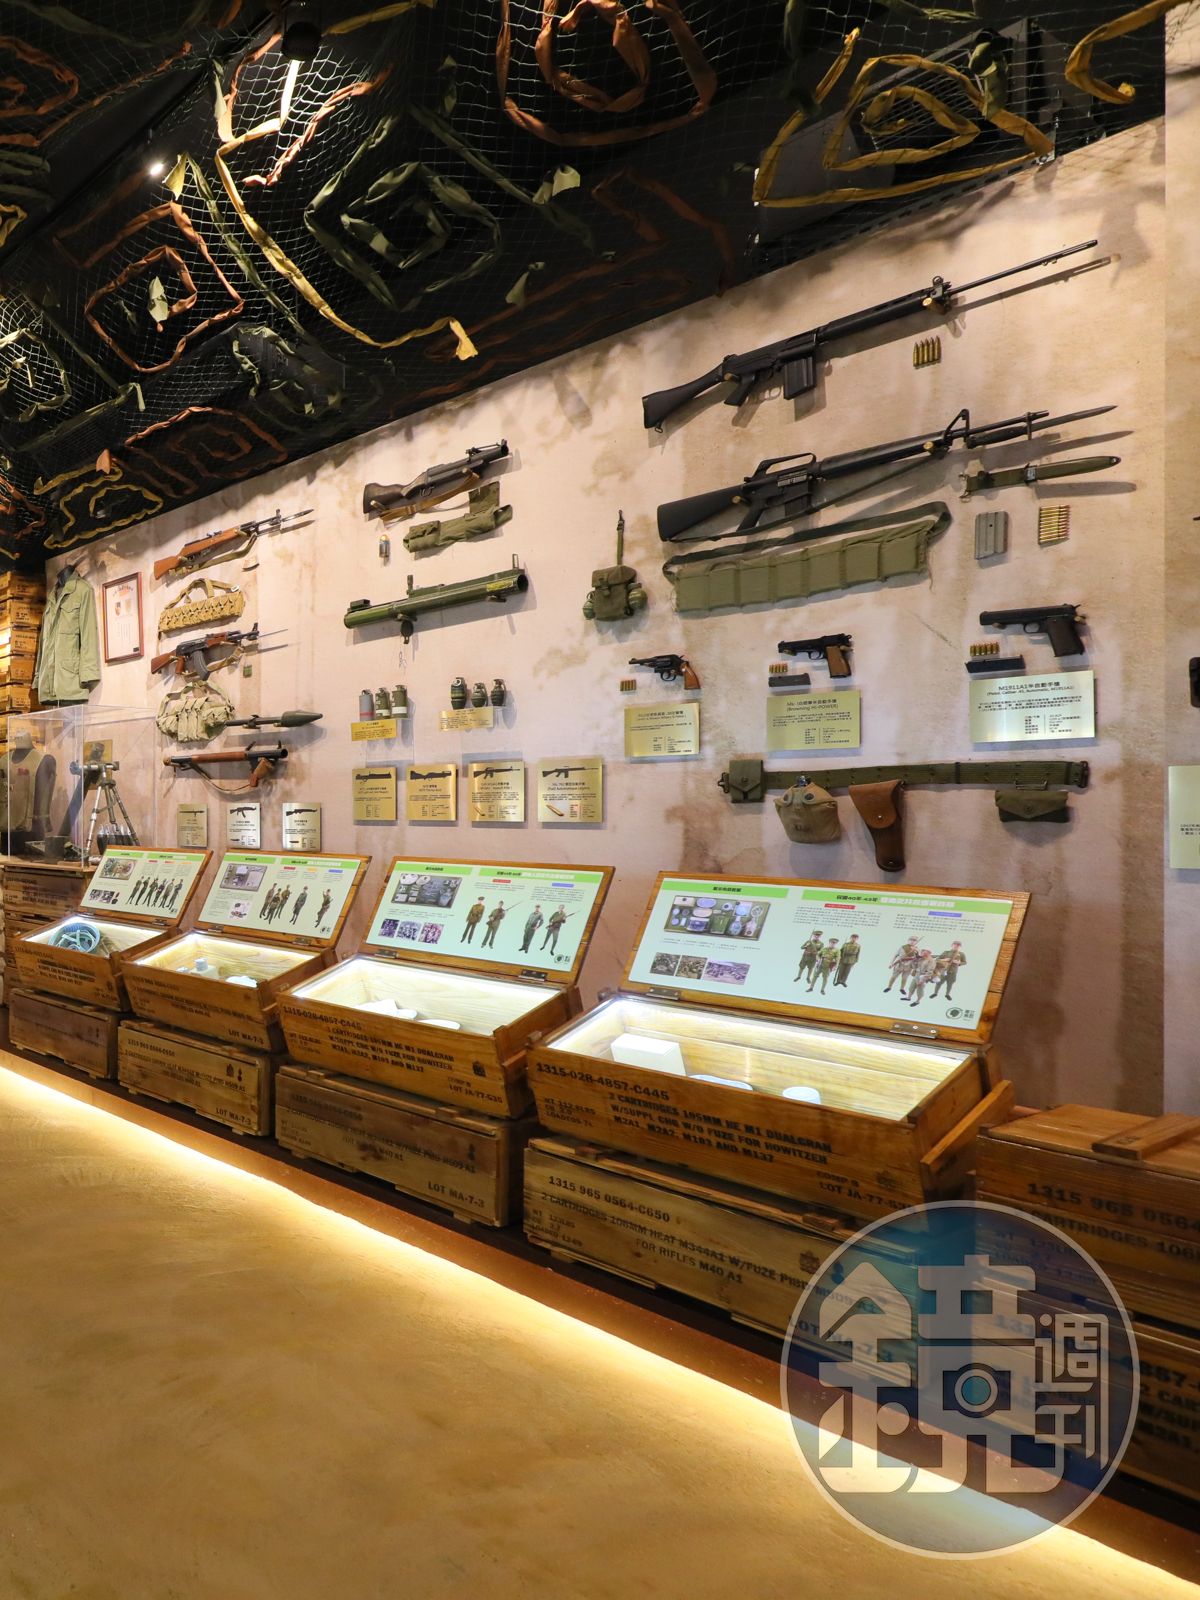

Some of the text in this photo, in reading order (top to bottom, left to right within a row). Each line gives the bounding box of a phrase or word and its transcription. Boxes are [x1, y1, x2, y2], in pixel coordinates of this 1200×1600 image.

[536, 1062, 670, 1101] 1315-028-4857-C445
[617, 1094, 680, 1116] CARTRIDGES
[707, 1126, 735, 1142] FUZE
[738, 1135, 761, 1149] FOR
[716, 1141, 738, 1154] AND
[428, 1180, 445, 1194] LOT
[819, 1181, 843, 1195] LOT
[548, 1176, 670, 1223] 1315 965 0564-C650
[1027, 1183, 1082, 1205] 1315
[1090, 1196, 1135, 1217] 965
[650, 1229, 677, 1245] HEAT
[636, 1238, 743, 1285] FOR RIFLES M40 A1
